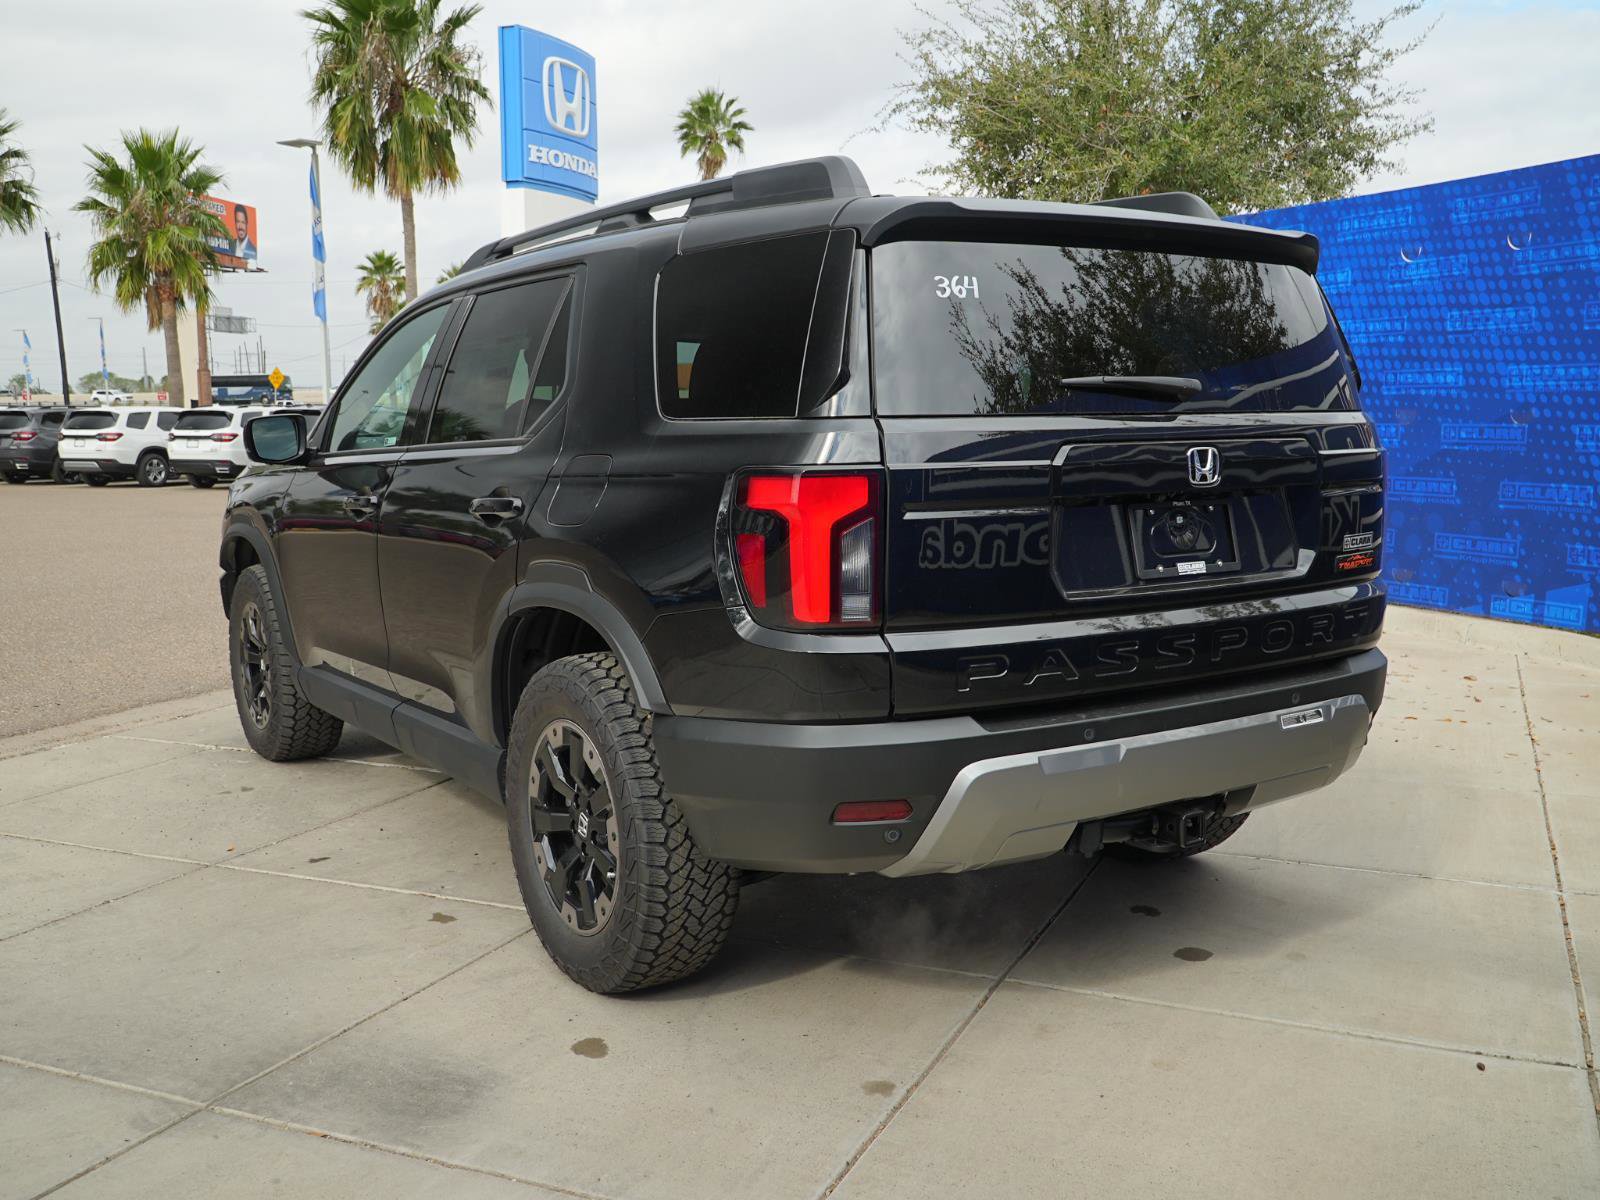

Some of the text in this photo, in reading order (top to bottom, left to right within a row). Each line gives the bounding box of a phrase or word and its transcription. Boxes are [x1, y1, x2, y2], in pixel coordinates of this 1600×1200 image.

[528, 143, 598, 176] HONDA
[933, 275, 979, 299] 364
[1351, 536, 1372, 546] CLARK
[1510, 600, 1579, 620] CLRK
[954, 609, 1370, 693] PASSPORT
